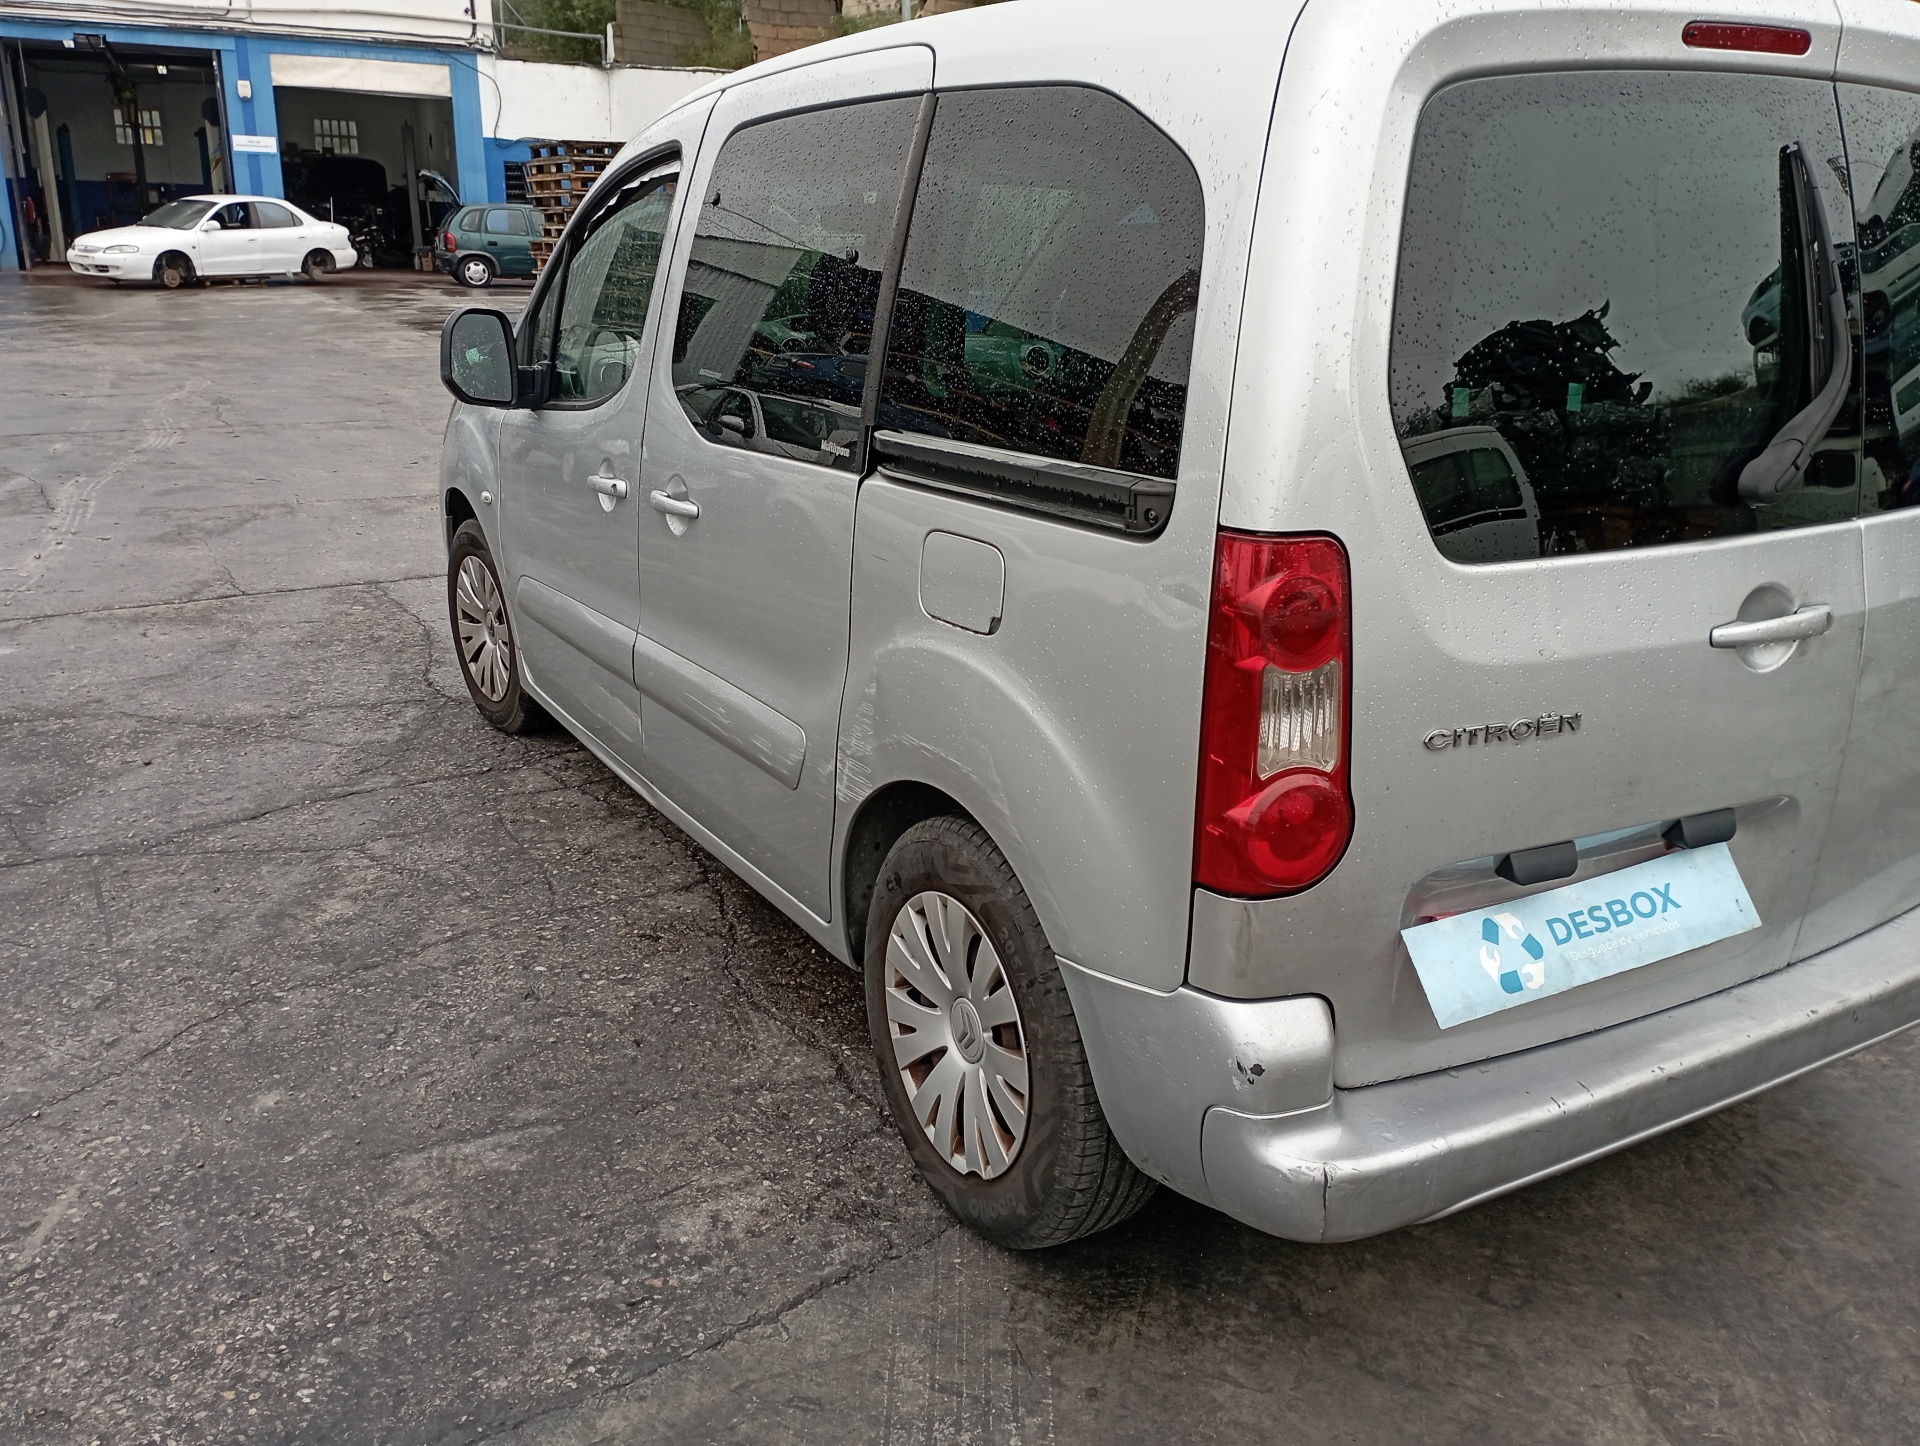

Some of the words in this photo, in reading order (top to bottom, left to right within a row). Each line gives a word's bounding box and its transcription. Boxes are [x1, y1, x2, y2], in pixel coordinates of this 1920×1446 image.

[1424, 711, 1582, 750] CITROËN
[1546, 883, 1682, 945] DESBOX
[1570, 939, 1618, 961] Desguace
[1619, 935, 1633, 946] de
